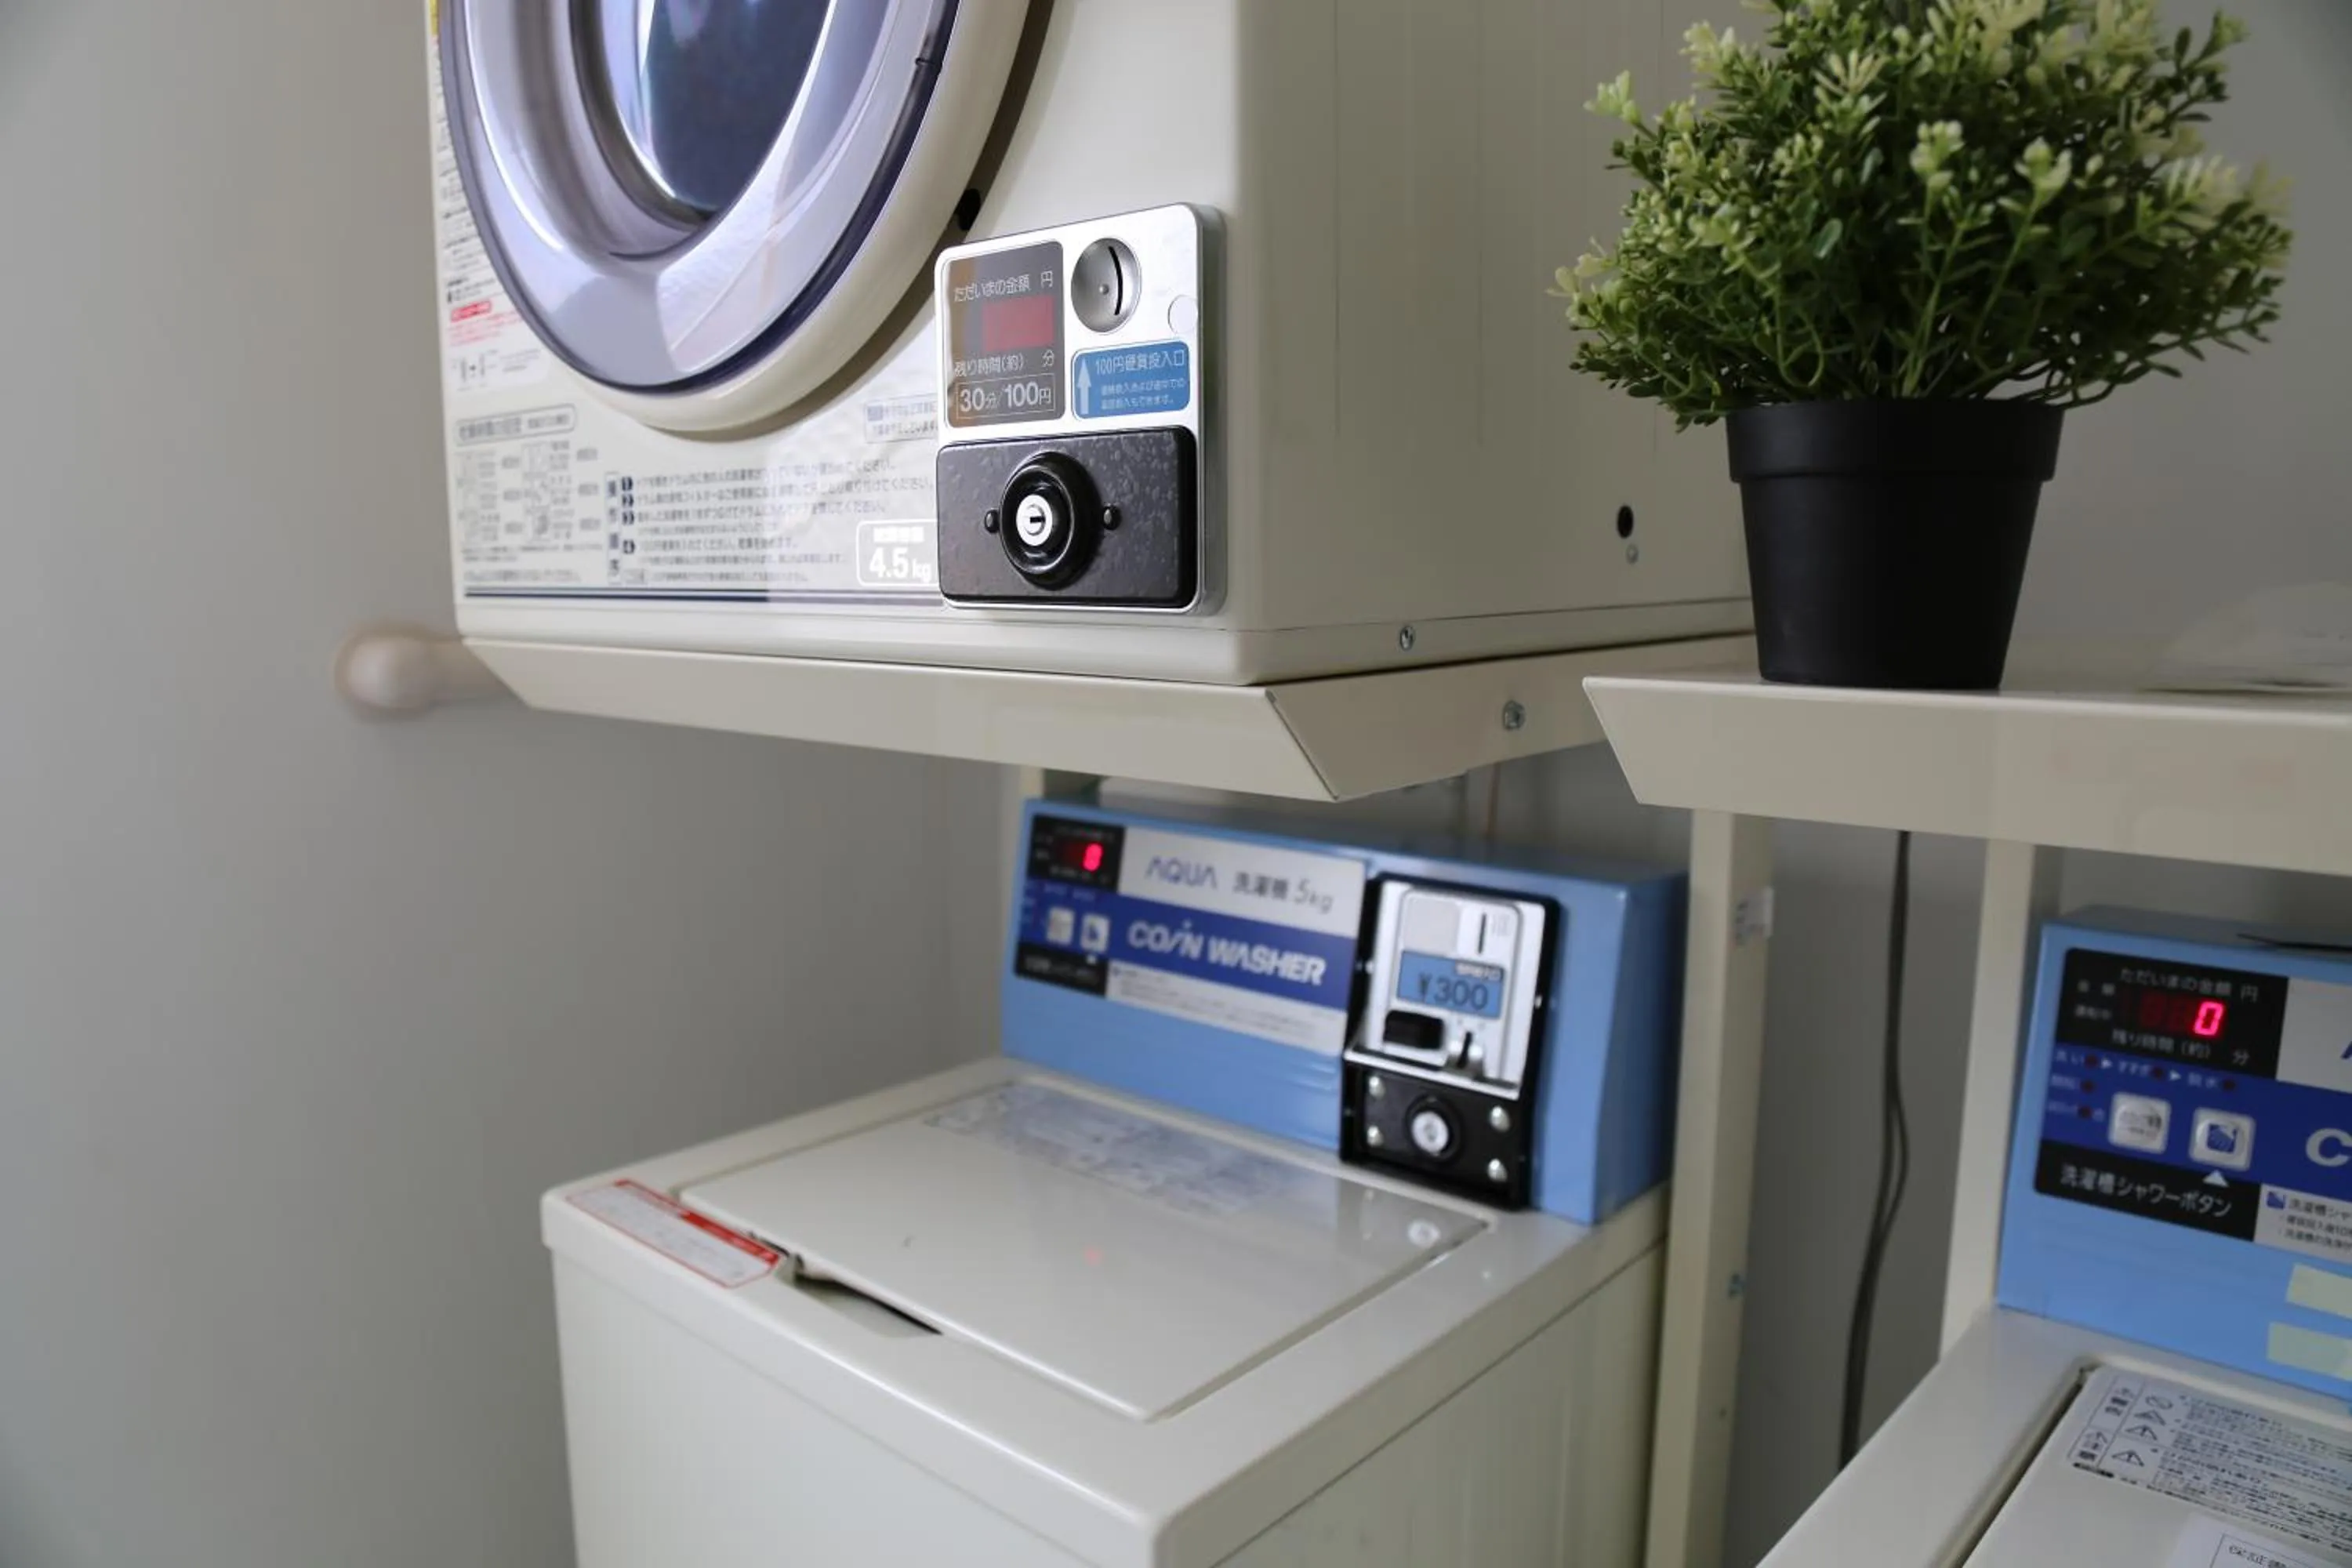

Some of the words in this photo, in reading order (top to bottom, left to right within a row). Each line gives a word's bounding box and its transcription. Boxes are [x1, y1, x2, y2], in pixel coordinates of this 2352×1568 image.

[954, 274, 1030, 302] ただいまの金額
[1040, 270, 1053, 289] 円
[1042, 350, 1055, 368] 分
[1127, 918, 1201, 963] COIN
[1207, 935, 1327, 986] WASHER
[2120, 968, 2232, 996] ただいまの金額
[2194, 1000, 2224, 1036] 0
[2060, 1163, 2233, 1219] 洗濯槽シャワーボタン
